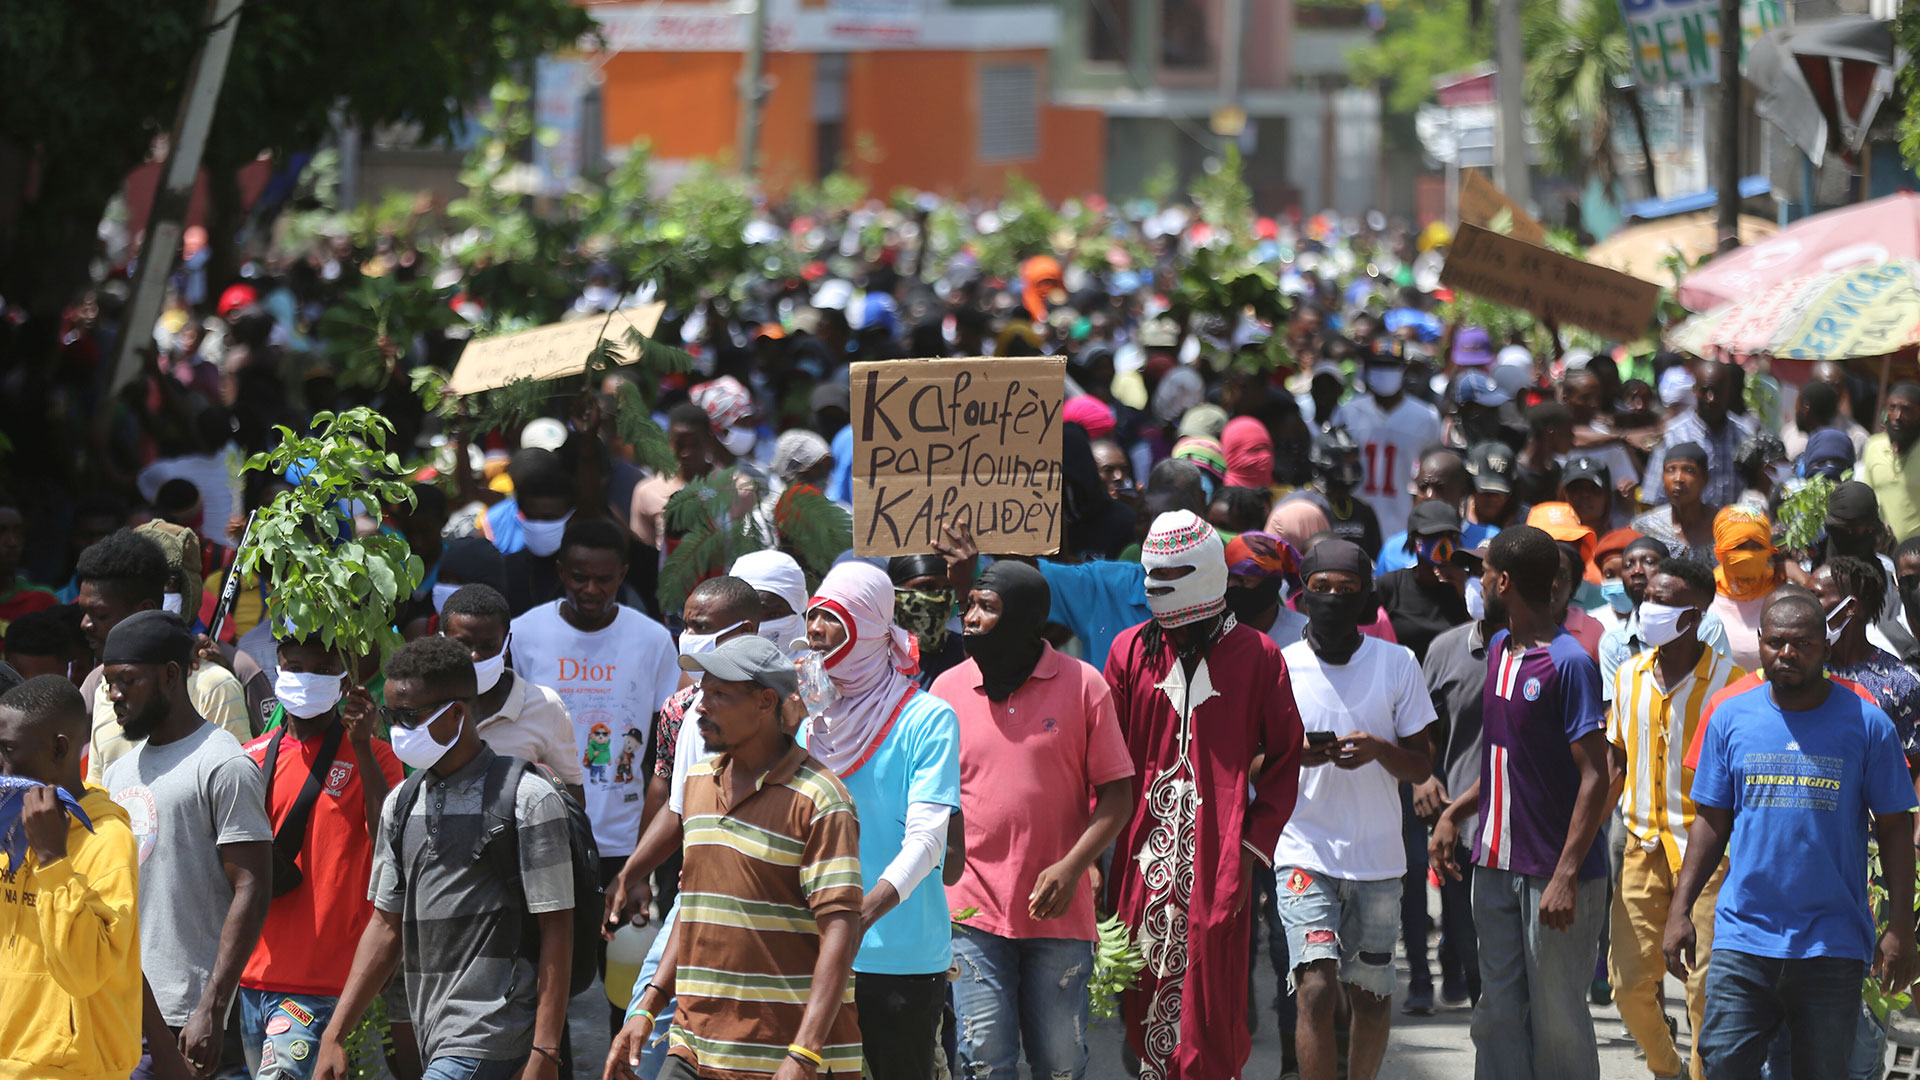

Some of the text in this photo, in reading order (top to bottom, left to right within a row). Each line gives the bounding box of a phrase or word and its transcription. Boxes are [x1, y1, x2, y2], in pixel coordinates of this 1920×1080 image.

[1364, 440, 1398, 499] 11
[557, 657, 616, 682] Dior
[1745, 775, 1841, 790] SUMMER NIGHTS
